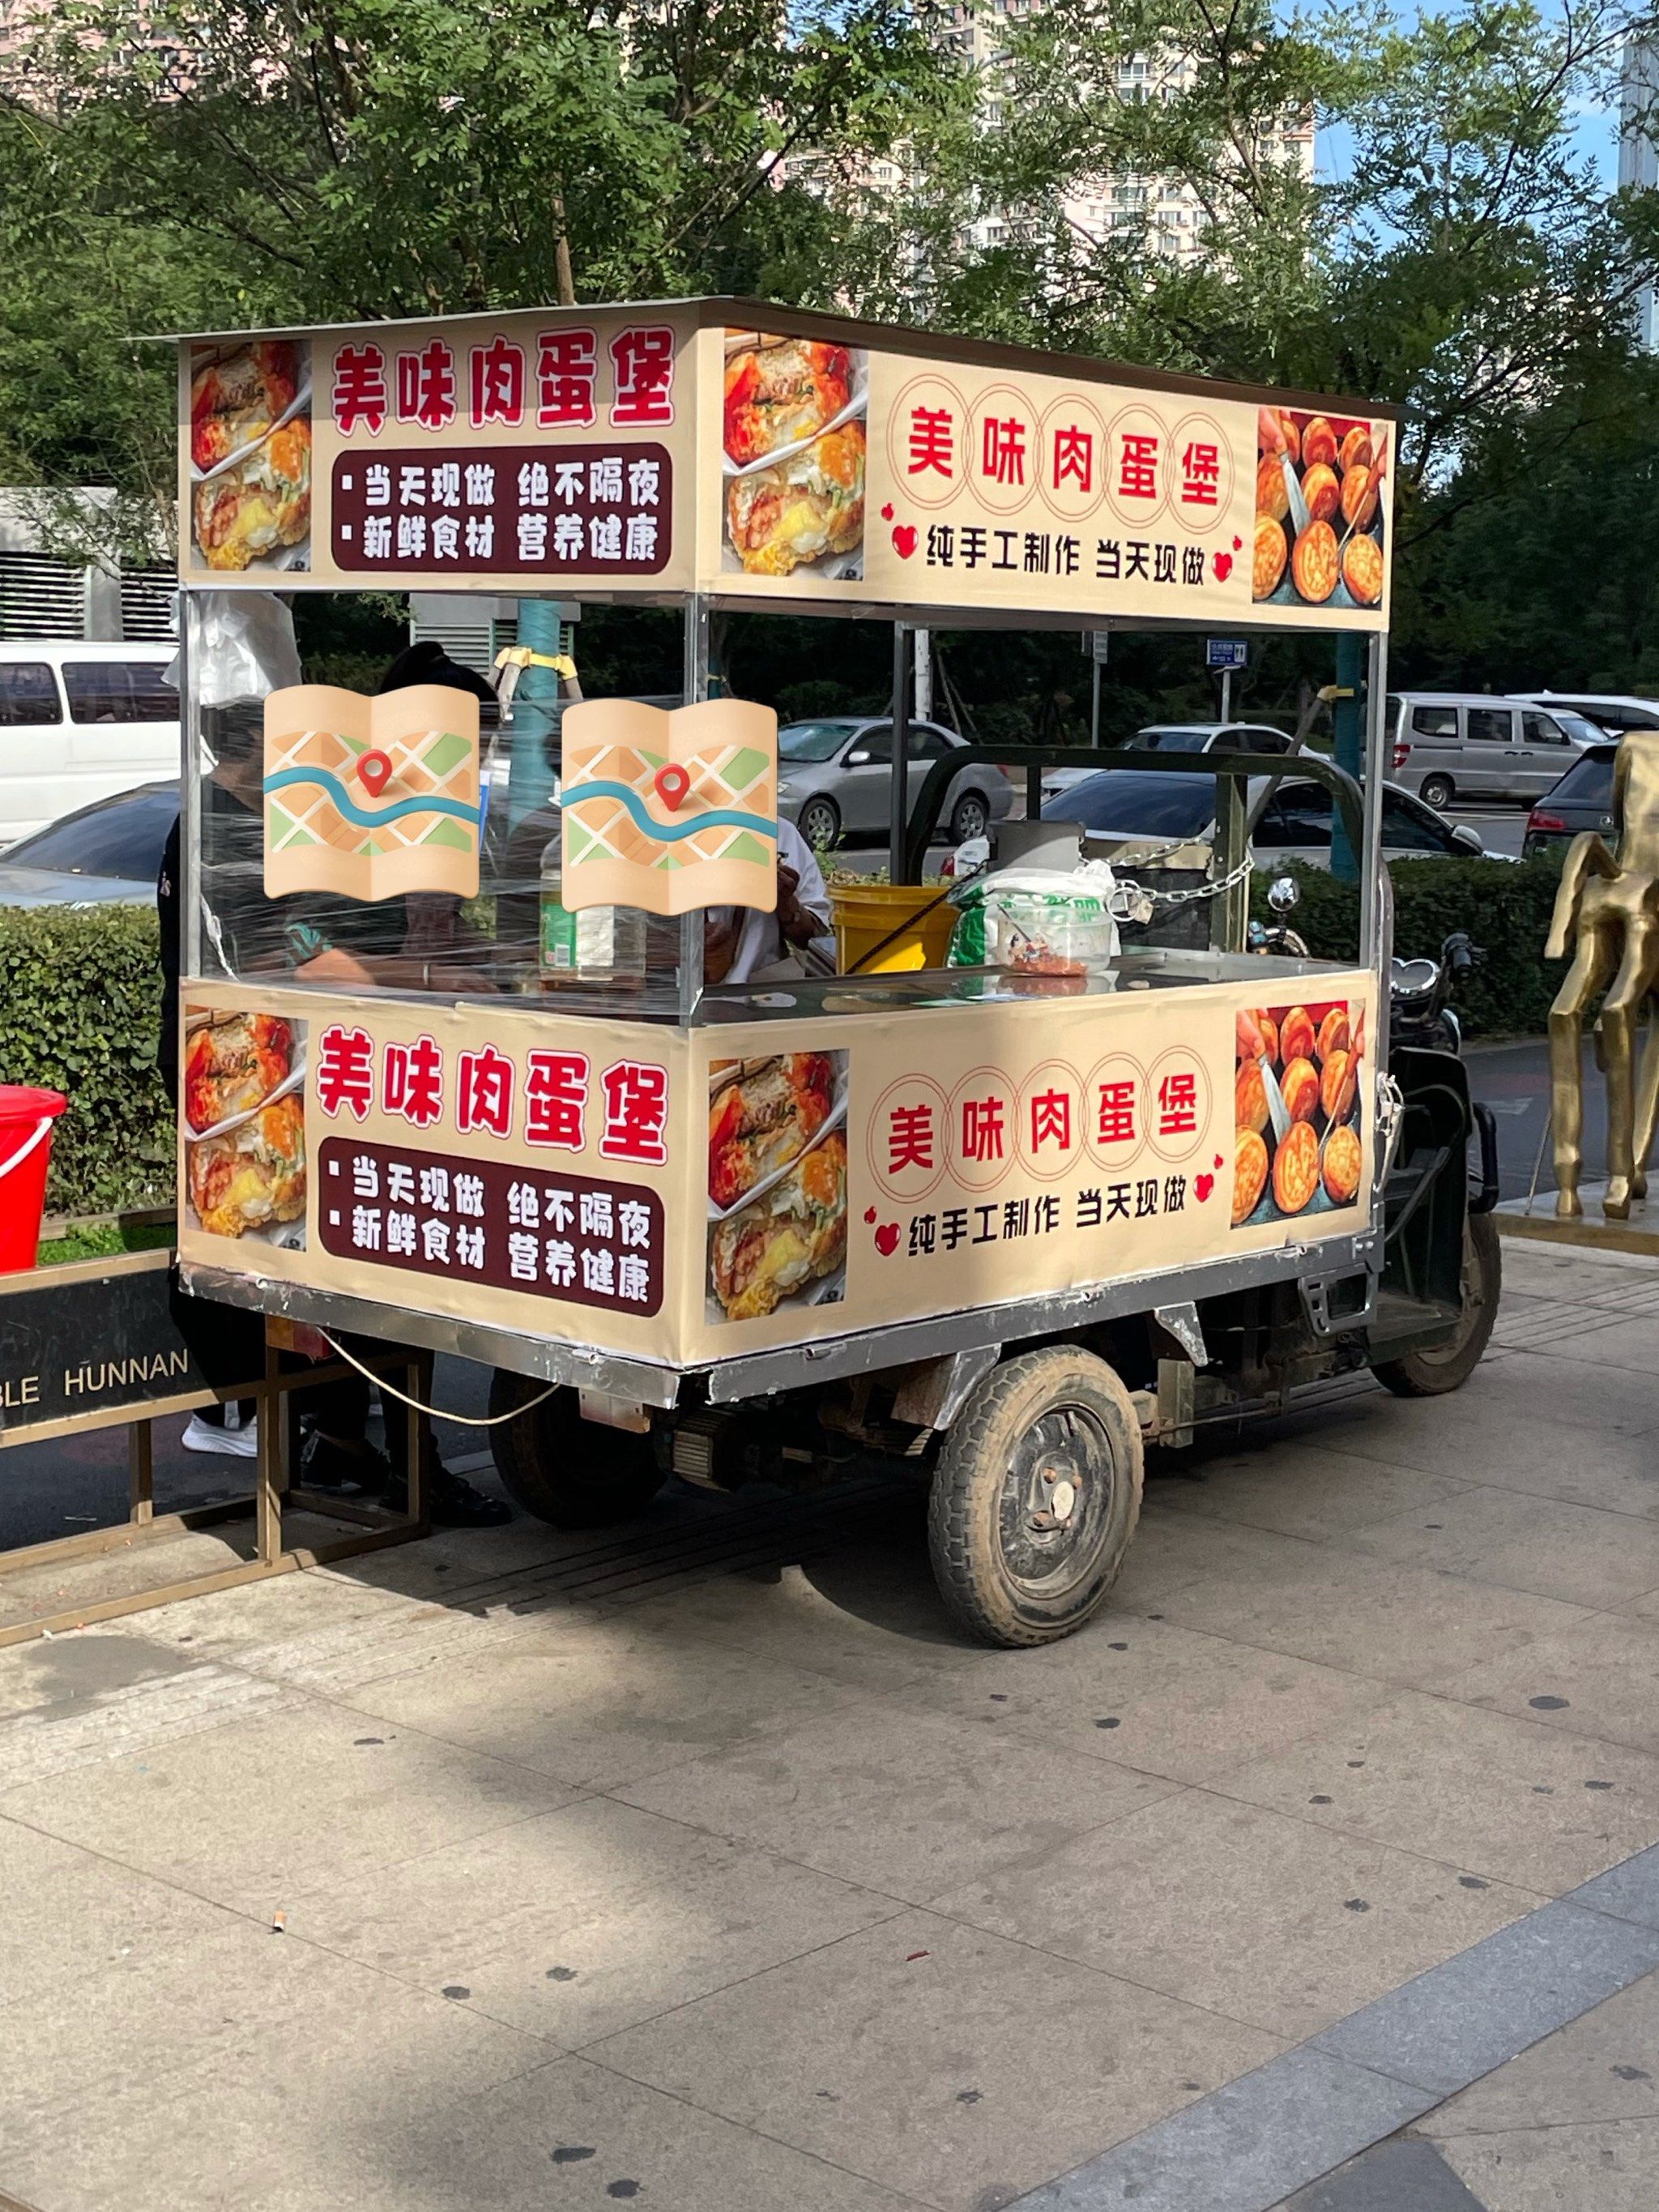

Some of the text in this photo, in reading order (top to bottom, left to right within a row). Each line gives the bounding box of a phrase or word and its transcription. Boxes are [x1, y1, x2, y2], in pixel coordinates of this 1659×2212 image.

[332, 326, 675, 437] 美味肉蛋堡
[364, 457, 660, 507] 当天现做 绝不隔夜
[908, 406, 1220, 507] 美味肉蛋堡
[363, 513, 659, 561] 新鲜食材 营养健康
[926, 525, 1205, 586] 纯手工制作 当天现做
[317, 1024, 669, 1167] 美味肉蛋堡
[888, 1074, 1197, 1174] 美味肉蛋堡
[352, 1156, 651, 1249] 当天现做 绝不隔夜
[907, 1174, 1185, 1257] 纯手工制作 当天现做
[352, 1207, 650, 1304] 新鲜食材 营养健康
[0, 1348, 188, 1408] LE HUNNAN
